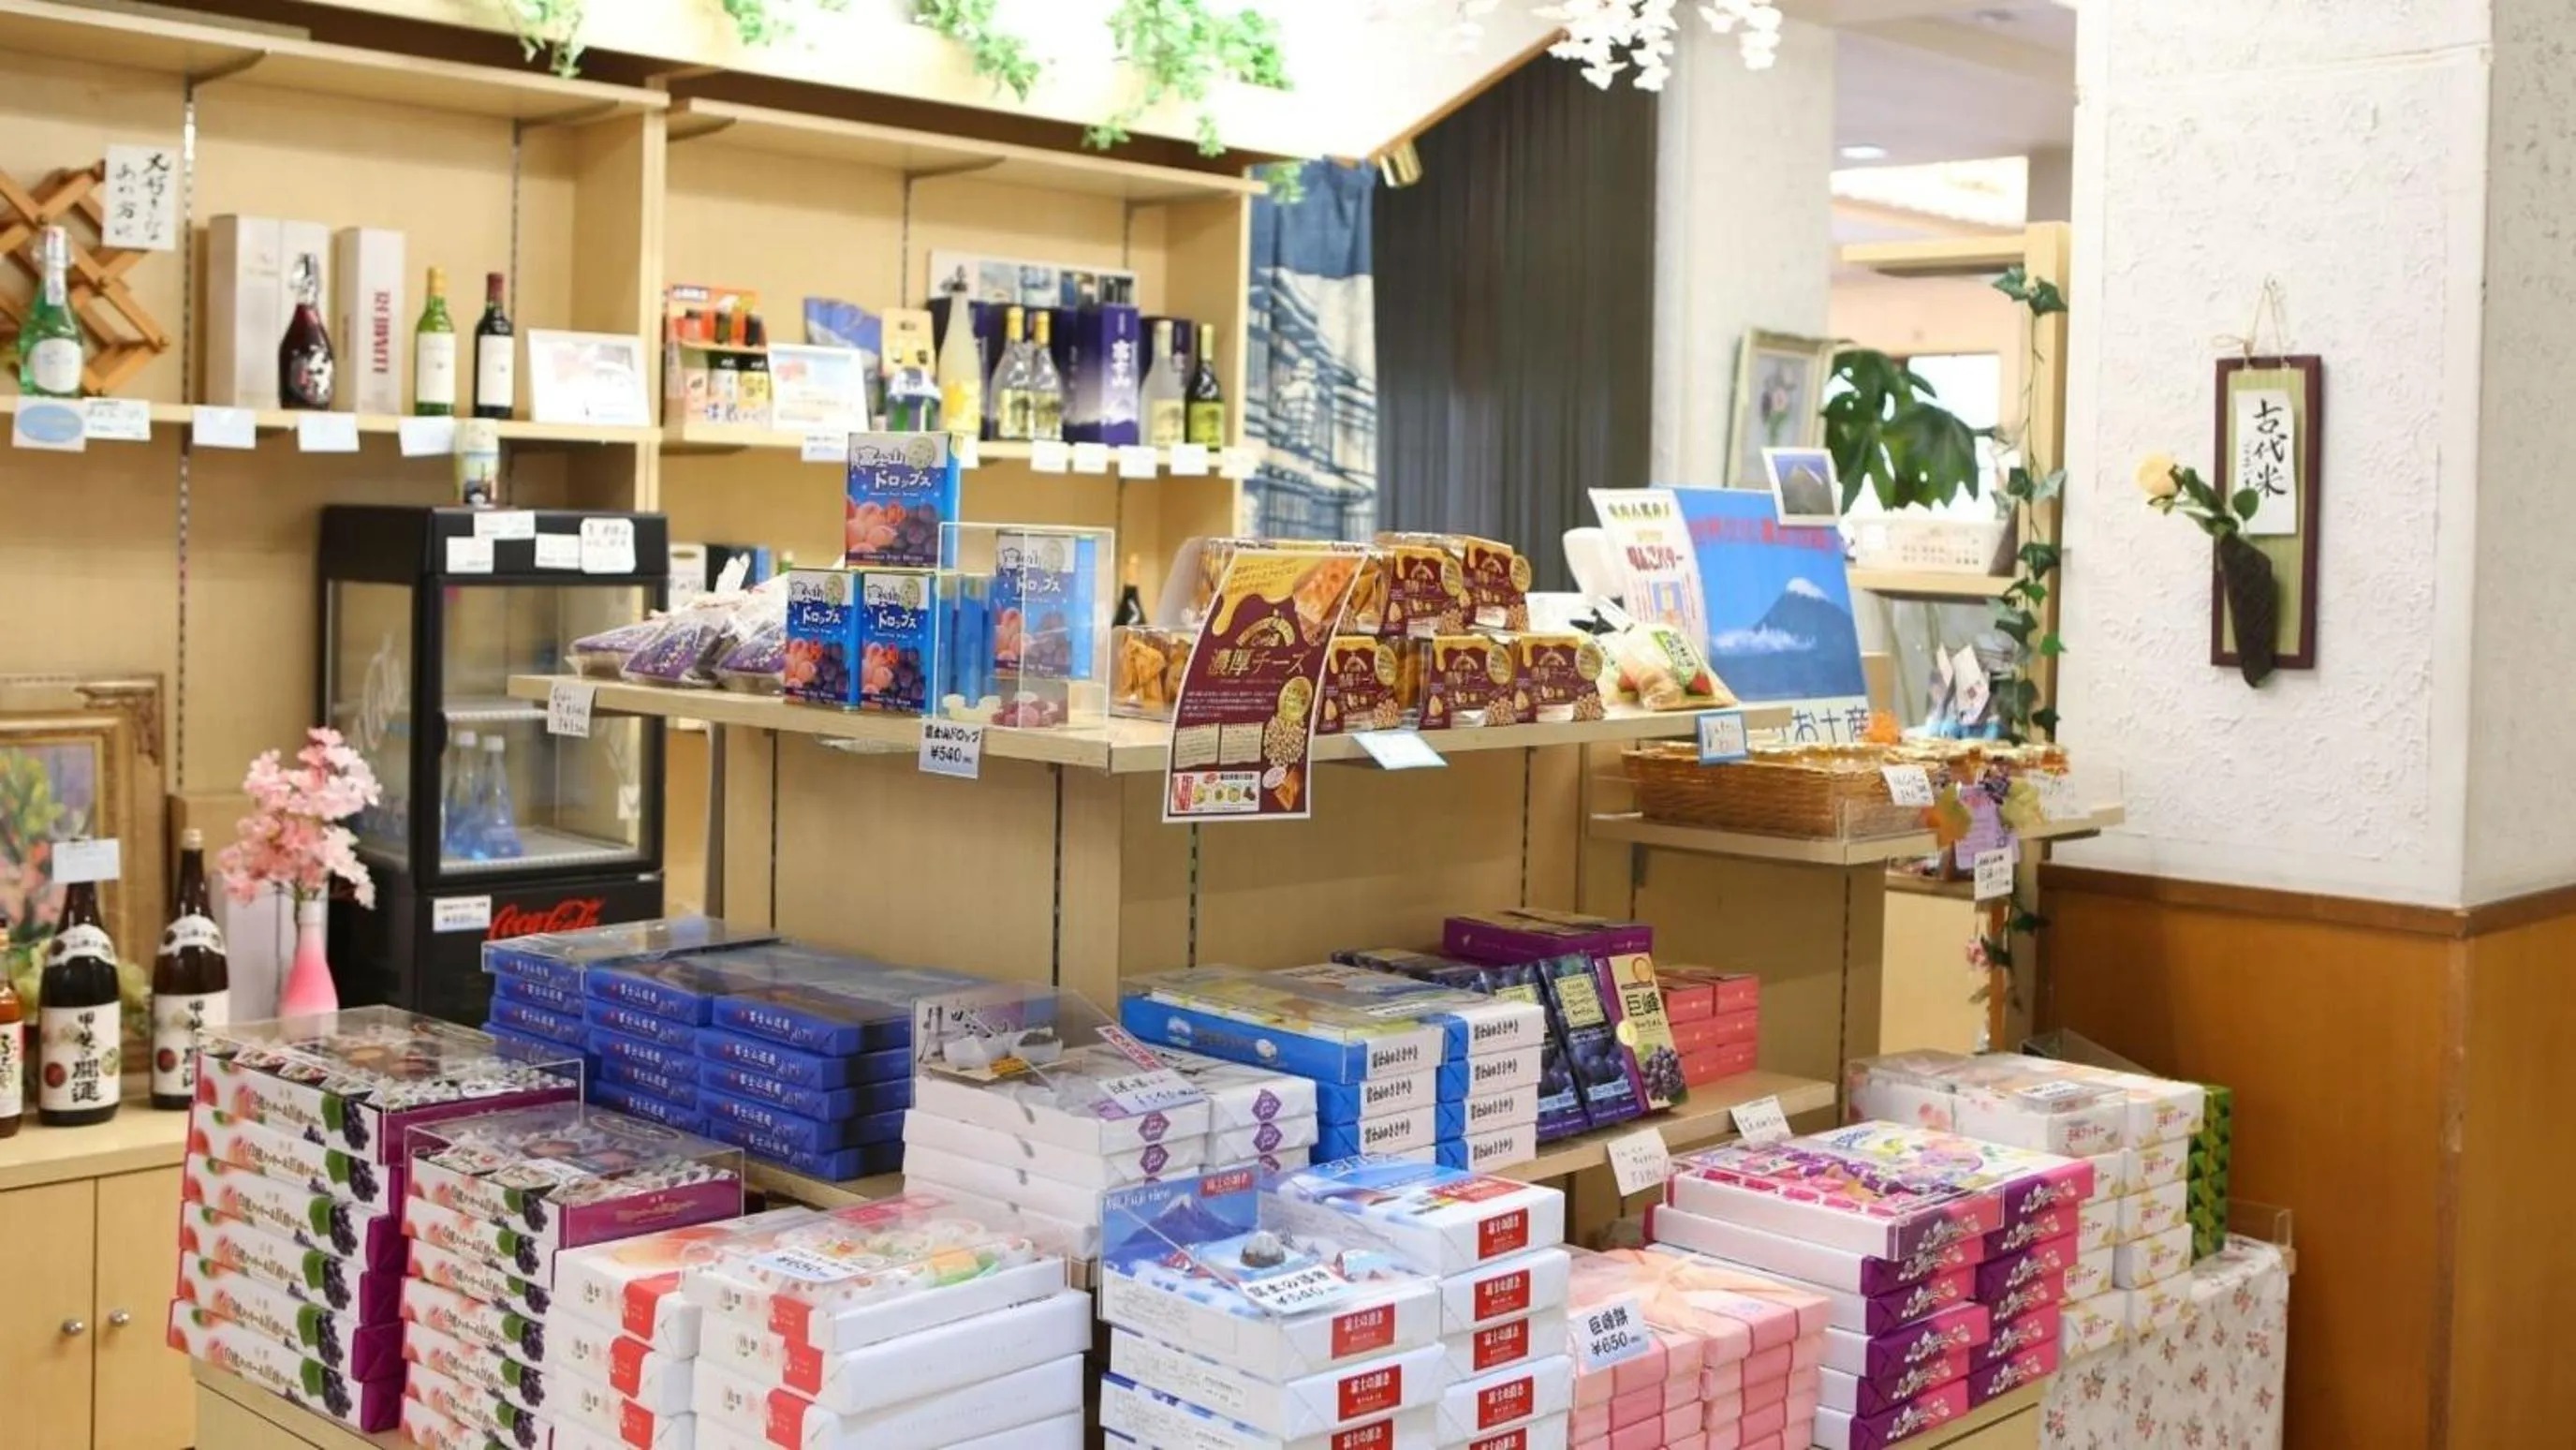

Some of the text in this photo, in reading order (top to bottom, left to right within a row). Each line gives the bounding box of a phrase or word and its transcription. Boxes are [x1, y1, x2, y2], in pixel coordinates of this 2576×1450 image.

[2253, 398, 2288, 498] 古代米
[875, 470, 933, 489] ドロップス
[802, 606, 842, 625] ドロップス
[878, 610, 917, 629] ドロップス
[1626, 991, 1660, 1016] 巨峰
[1588, 1306, 1628, 1336] 巨峰餅
[1590, 1331, 1627, 1356] ¥650
